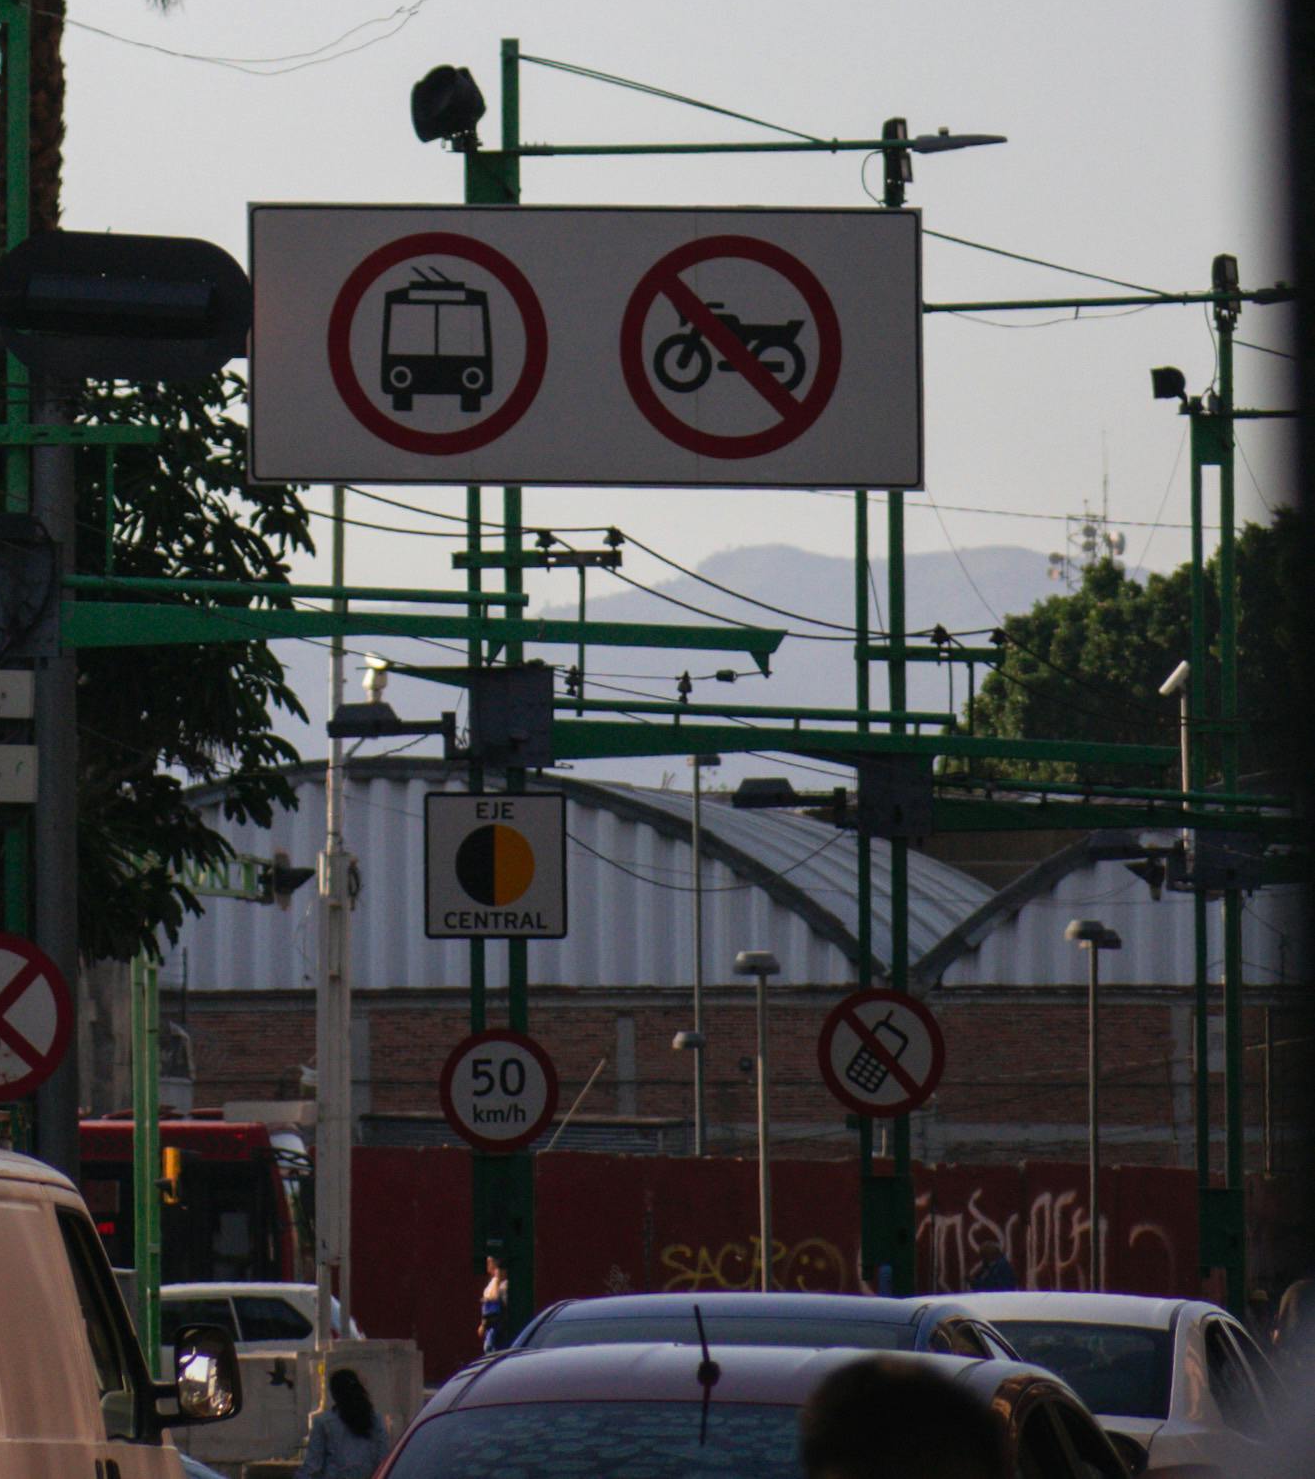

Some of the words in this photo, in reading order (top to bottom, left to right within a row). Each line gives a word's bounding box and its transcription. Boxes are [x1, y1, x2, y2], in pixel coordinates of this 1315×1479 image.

[476, 801, 515, 820] EJE
[444, 911, 548, 930] CENTRAL
[471, 1058, 526, 1098] 50
[472, 1103, 527, 1125] km/h
